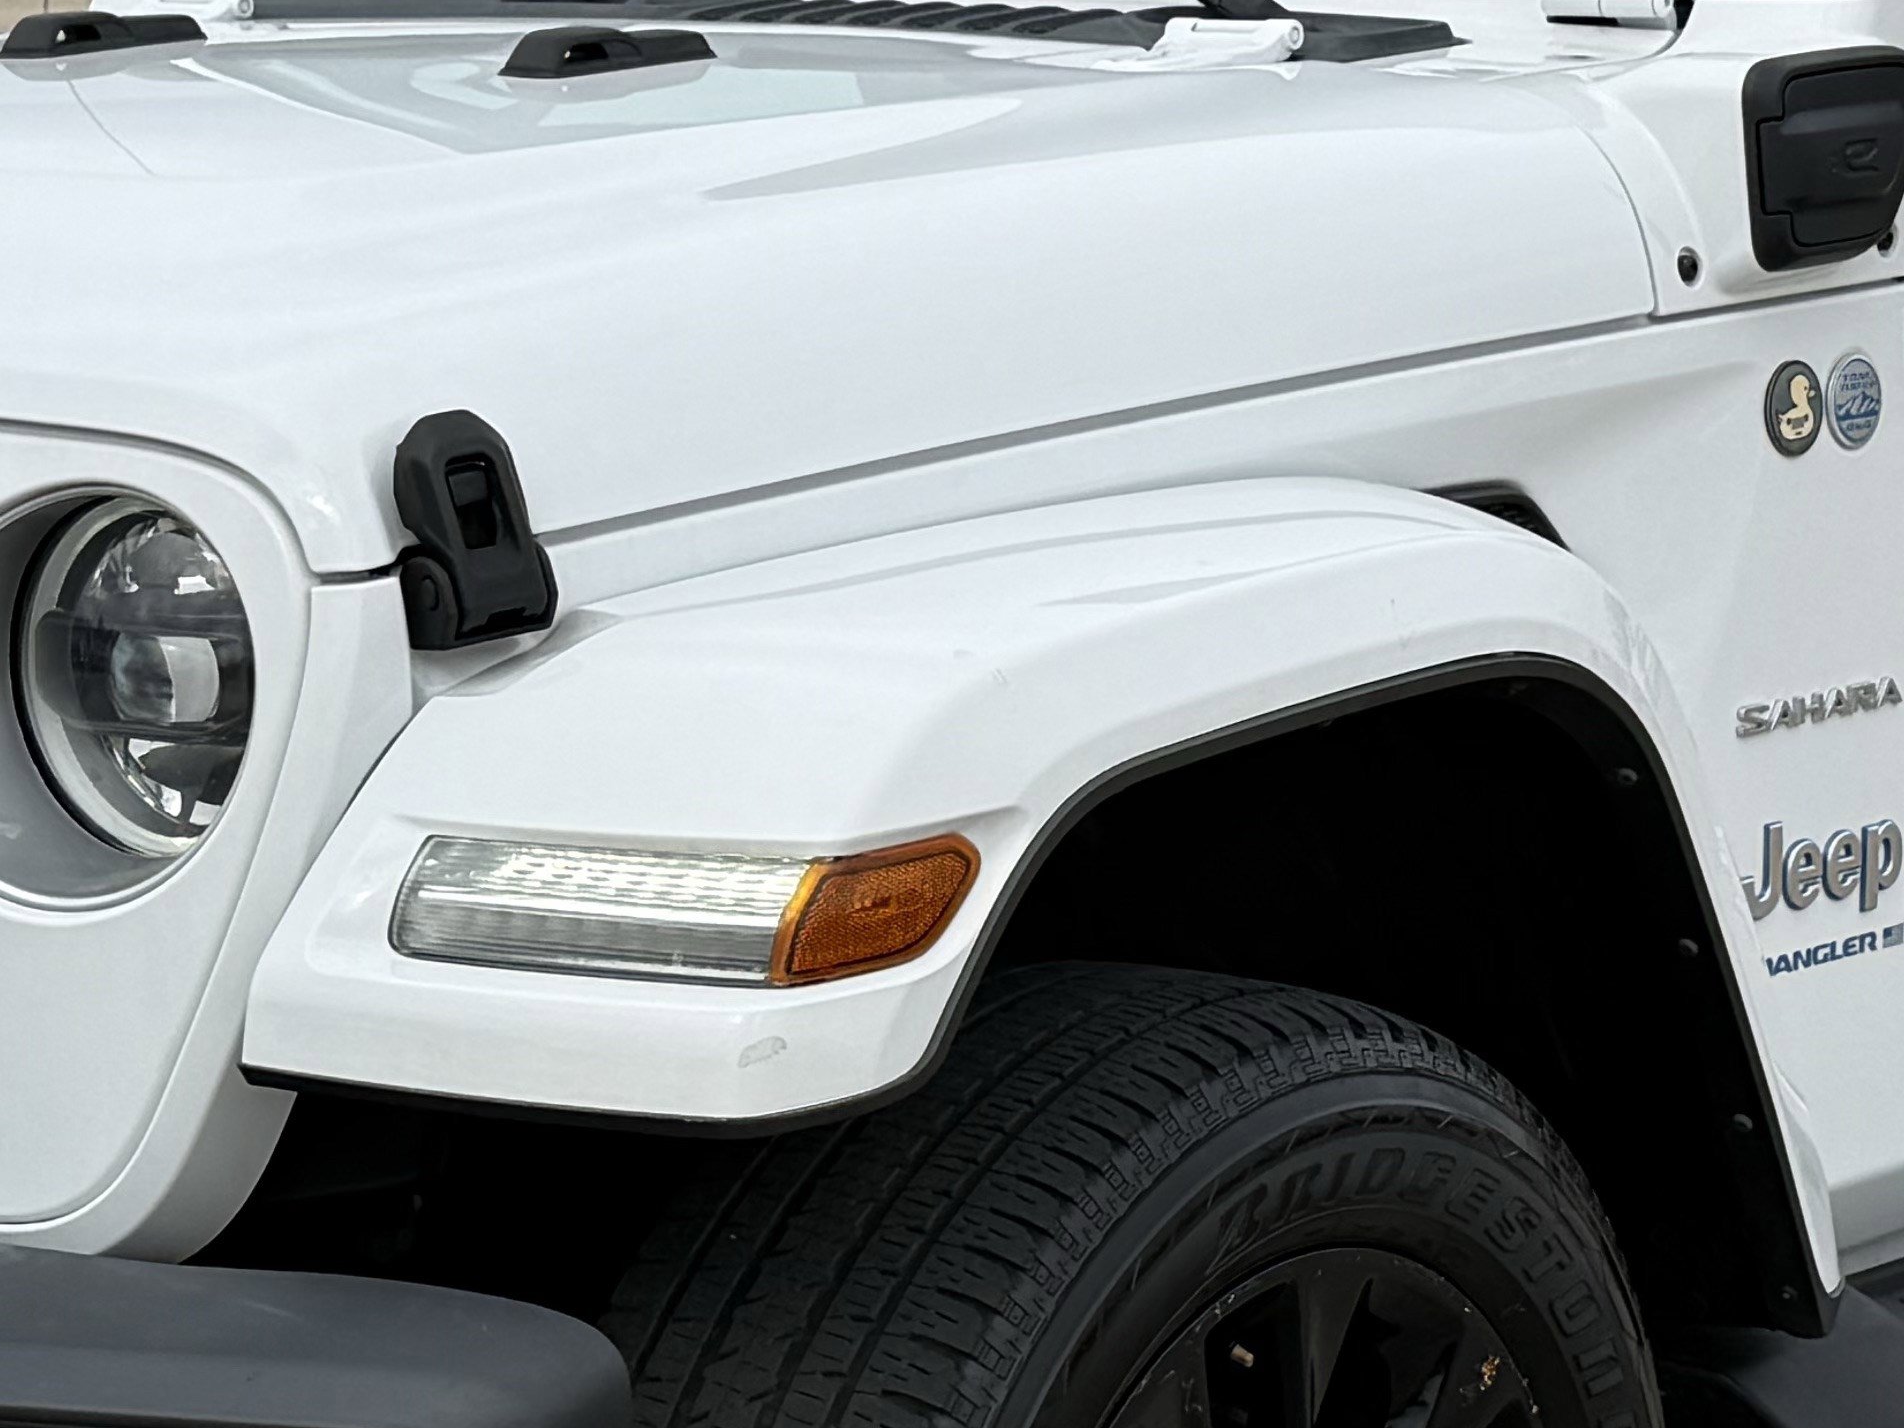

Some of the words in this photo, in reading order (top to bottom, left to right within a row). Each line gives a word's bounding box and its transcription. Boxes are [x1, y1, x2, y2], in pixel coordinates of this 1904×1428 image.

[1736, 676, 1903, 738] SAHARA
[1740, 818, 1903, 922] Jeep
[1764, 931, 1878, 976] ANGLER
